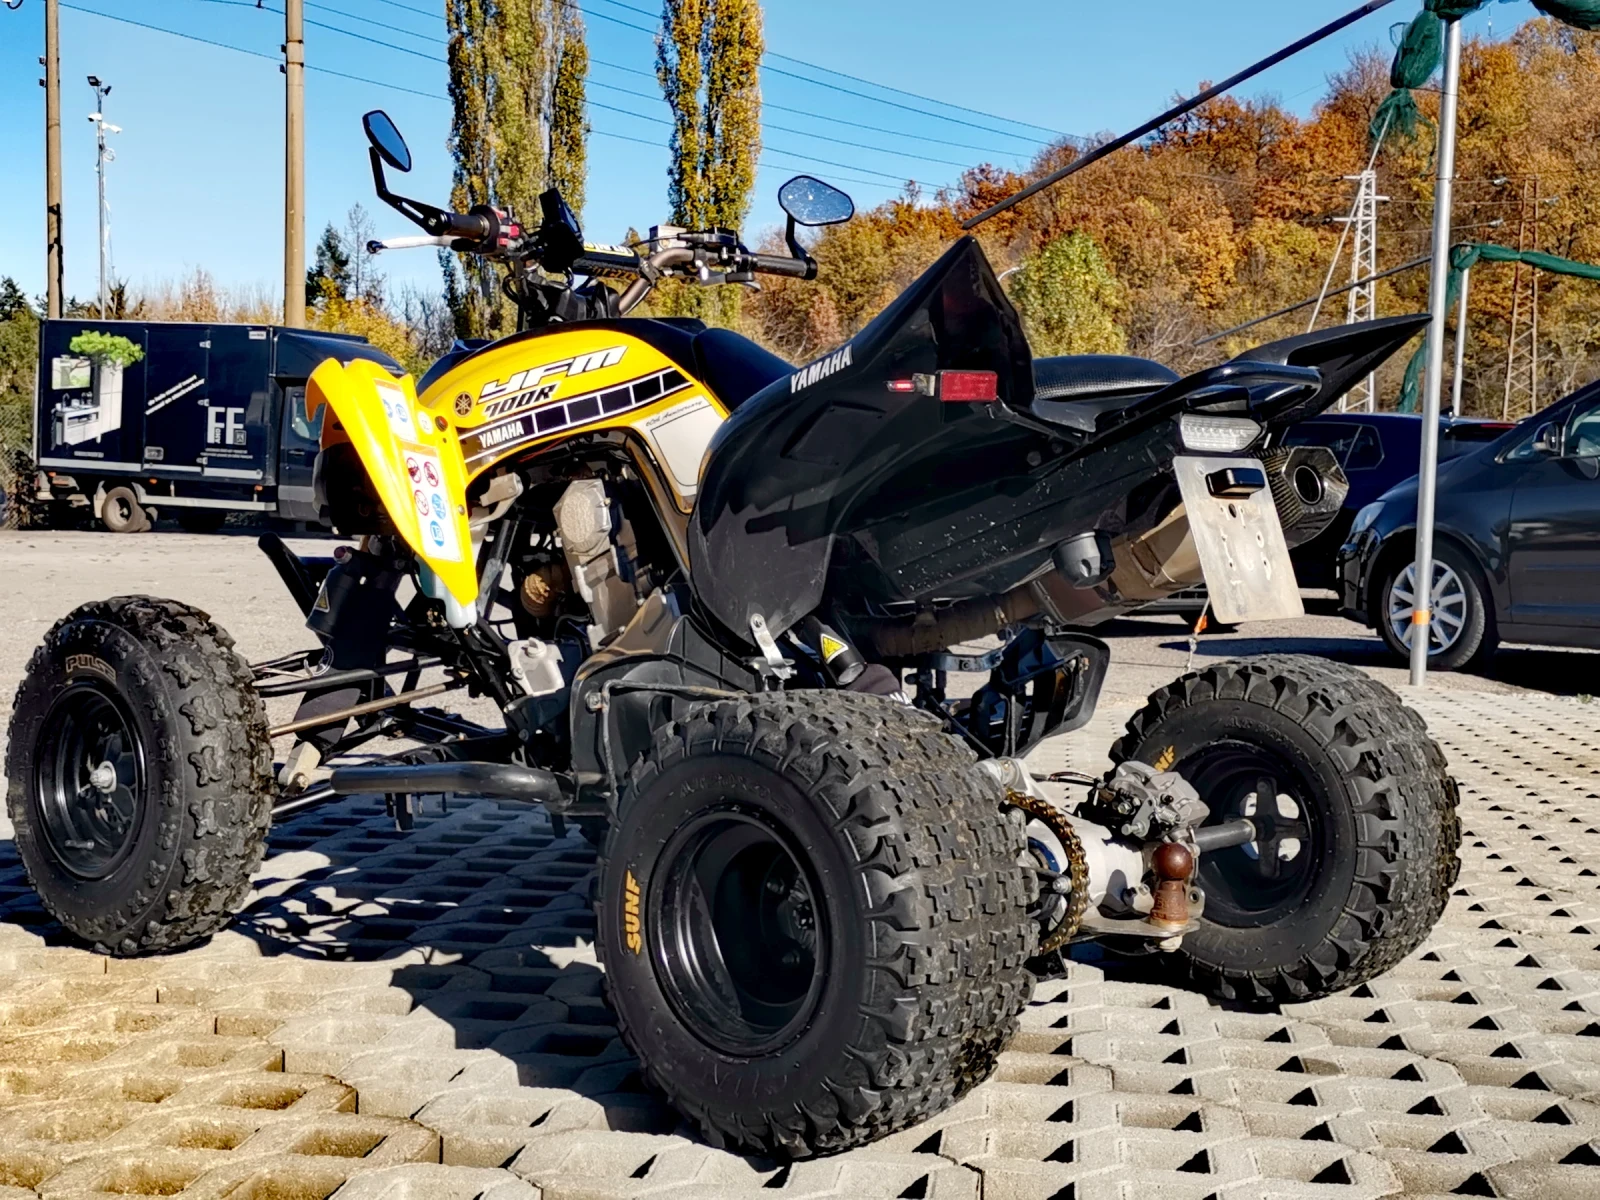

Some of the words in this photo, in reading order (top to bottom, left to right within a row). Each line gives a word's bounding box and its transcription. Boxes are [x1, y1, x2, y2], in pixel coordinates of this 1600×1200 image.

[476, 345, 628, 405] YFM
[791, 344, 853, 394] YAMAHA
[483, 382, 559, 418] 700R
[479, 421, 525, 449] YAMAHA
[65, 653, 117, 686] PULSE
[1154, 744, 1175, 773] NF
[625, 869, 642, 956] SUNF
